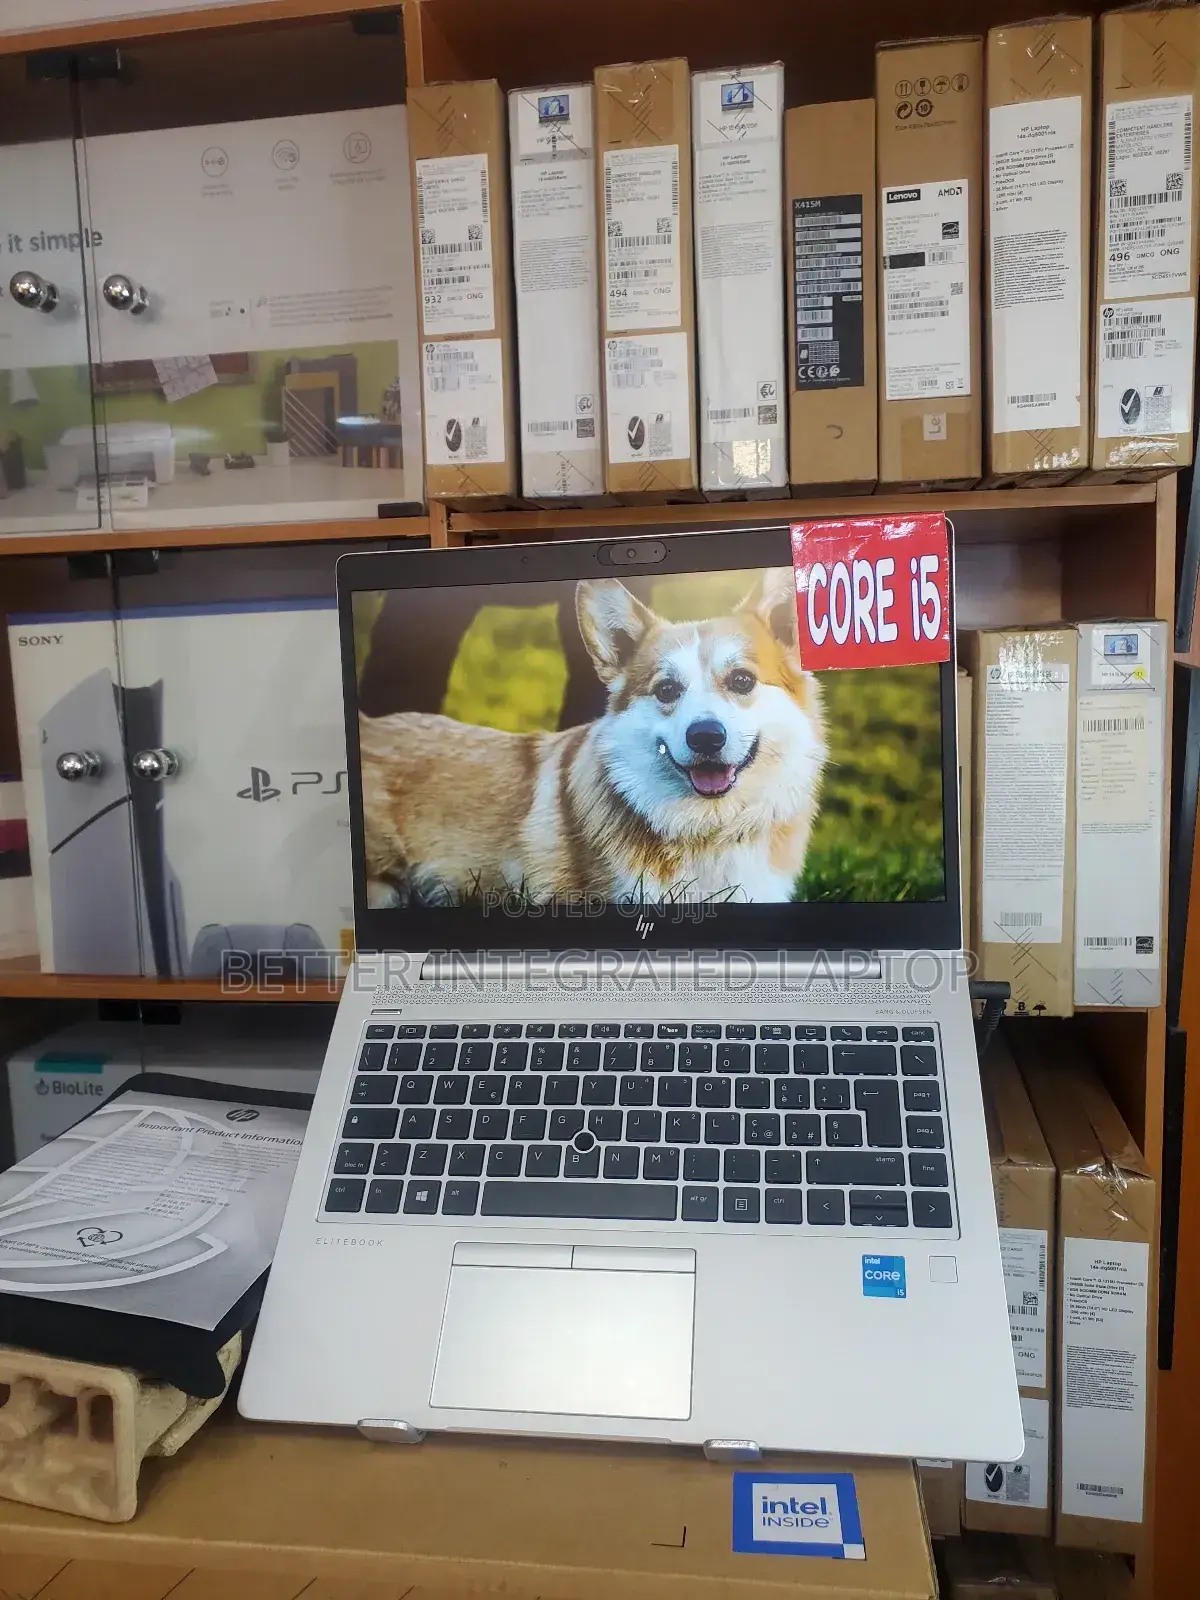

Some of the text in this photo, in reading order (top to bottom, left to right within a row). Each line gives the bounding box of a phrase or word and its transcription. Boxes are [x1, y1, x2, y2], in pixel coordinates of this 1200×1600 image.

[1031, 124, 1050, 132] Laptop
[888, 192, 918, 200] Lenovo
[938, 187, 956, 197] AMD
[795, 200, 822, 209] X415M
[8, 228, 103, 253] it simple
[1110, 248, 1180, 262] 496 ONG
[609, 286, 671, 298] 494 ONG
[424, 292, 484, 304] 932 ONG
[807, 554, 941, 646] CORE i5
[18, 635, 64, 647] SONY
[636, 914, 654, 940] hp
[648, 1058, 654, 1066] 8
[686, 1058, 692, 1066] 9
[52, 1080, 104, 1096] BioLite
[406, 1080, 416, 1090] Q
[443, 1080, 454, 1088] W
[478, 1080, 486, 1089] E
[515, 1081, 522, 1089] R
[552, 1081, 558, 1089] T
[590, 1081, 597, 1089] Y
[628, 1082, 634, 1090] U
[704, 1083, 712, 1091] O
[742, 1084, 749, 1092] P
[226, 1108, 260, 1122] hp
[408, 1115, 417, 1124] A
[446, 1115, 452, 1124] S
[482, 1116, 490, 1124] D
[519, 1116, 526, 1124] F
[558, 1116, 566, 1124] G
[596, 1116, 602, 1124] H
[634, 1117, 640, 1125] J
[674, 1118, 680, 1126] K
[712, 1119, 718, 1127] L
[138, 1122, 194, 1133] Important
[196, 1127, 240, 1139] Product
[457, 1151, 465, 1160] X
[496, 1152, 504, 1160] C
[534, 1152, 542, 1160] V
[572, 1154, 580, 1162] B
[612, 1153, 620, 1162] N
[652, 1154, 660, 1162] M
[875, 1156, 896, 1164] stamp
[316, 1238, 384, 1246] ELITEBOOK
[864, 1257, 881, 1265] intel
[762, 1496, 827, 1515] intel
